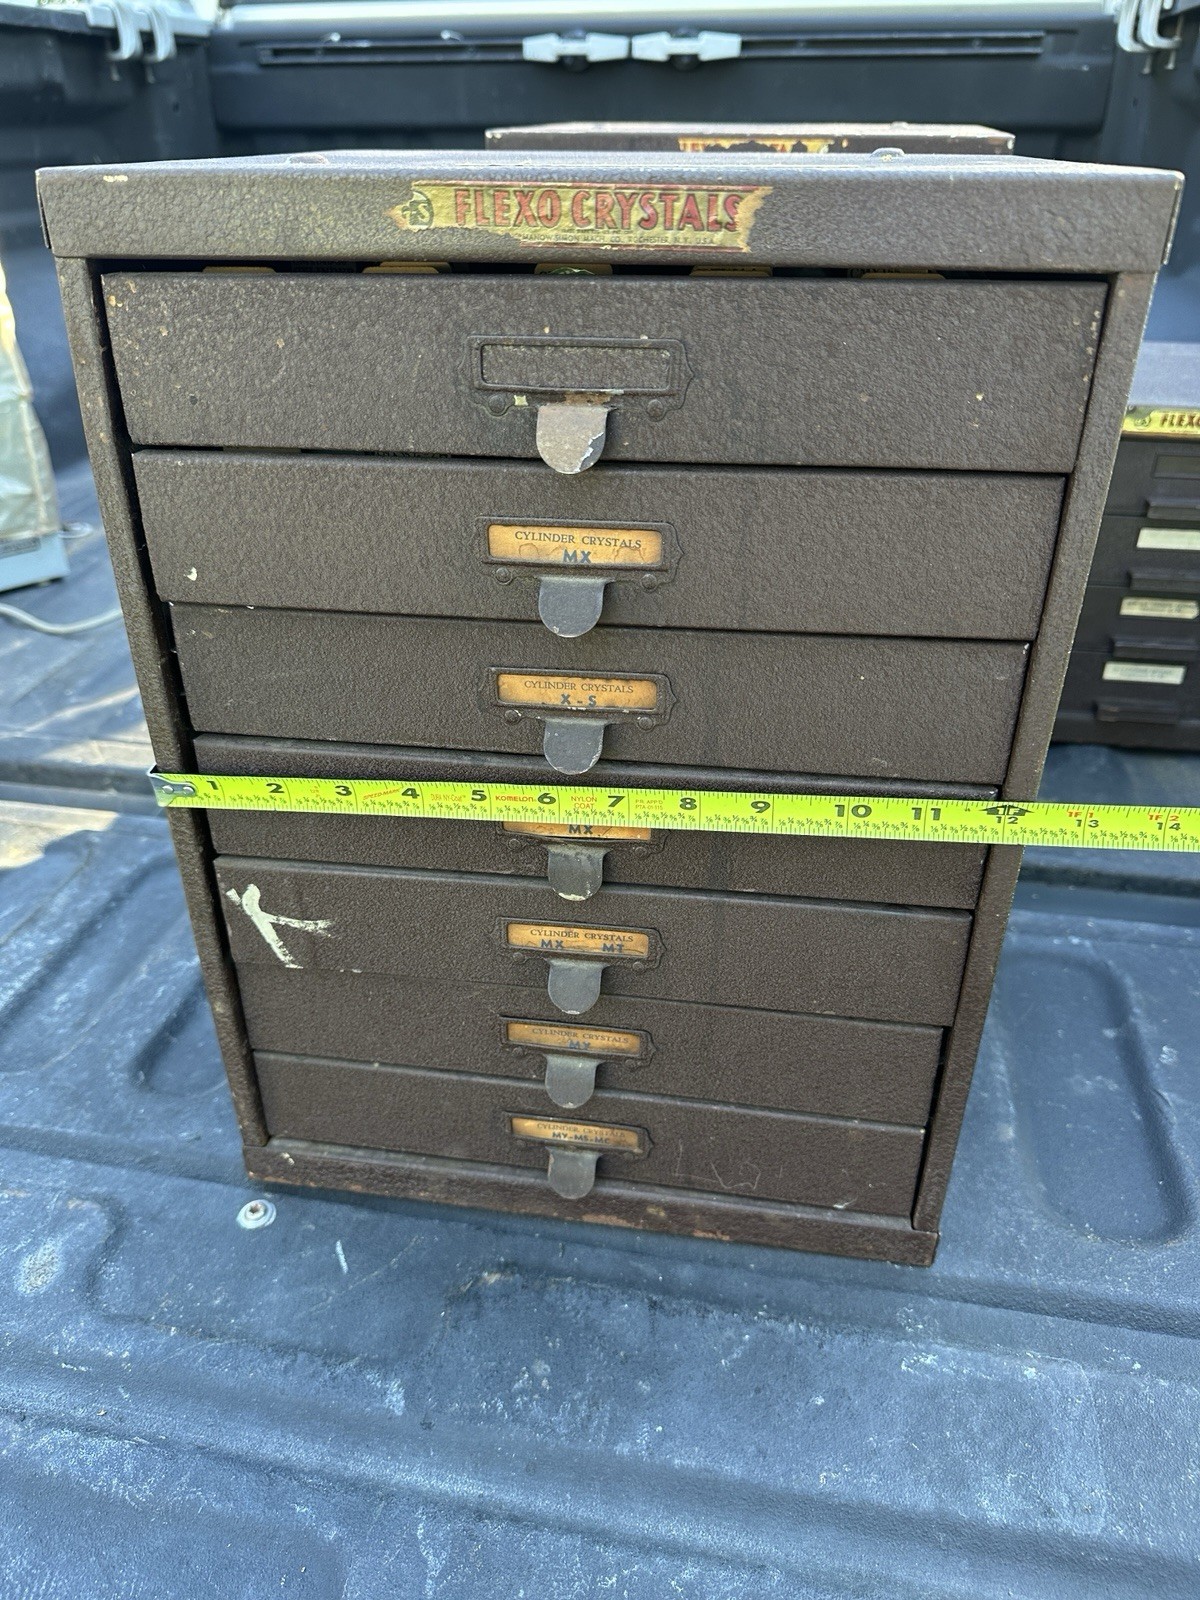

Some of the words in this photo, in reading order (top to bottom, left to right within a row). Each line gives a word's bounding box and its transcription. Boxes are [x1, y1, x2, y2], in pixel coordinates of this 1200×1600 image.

[454, 188, 561, 229] FLEXO
[571, 190, 741, 232] CRYSTALS
[515, 531, 576, 544] CYLINDER
[581, 535, 642, 549] CRYSTALS
[562, 549, 592, 564] MX
[524, 680, 576, 691] CYLINDER
[581, 683, 634, 694] CRYSTALS
[206, 780, 219, 791] 1
[266, 783, 285, 794] 2
[335, 785, 353, 796] 3
[401, 788, 420, 799] 4
[471, 790, 488, 802] 5
[537, 792, 556, 805] 6
[607, 795, 626, 807] 7
[679, 797, 698, 811] 8
[750, 801, 771, 814] 9
[834, 804, 873, 818] 10
[911, 807, 942, 821] 11
[996, 816, 1019, 825] 12
[1075, 819, 1099, 828] 13
[1157, 822, 1181, 831] 14
[569, 824, 594, 834] MX
[530, 928, 580, 939] CYLINDER
[584, 933, 634, 943] CRYSTALS
[541, 938, 565, 950] MX
[532, 1028, 578, 1038] CYLINDER
[582, 1033, 629, 1044] CRYSTALS
[537, 1122, 579, 1133] CYLINDER
[583, 1127, 626, 1138] CRYSTALS
